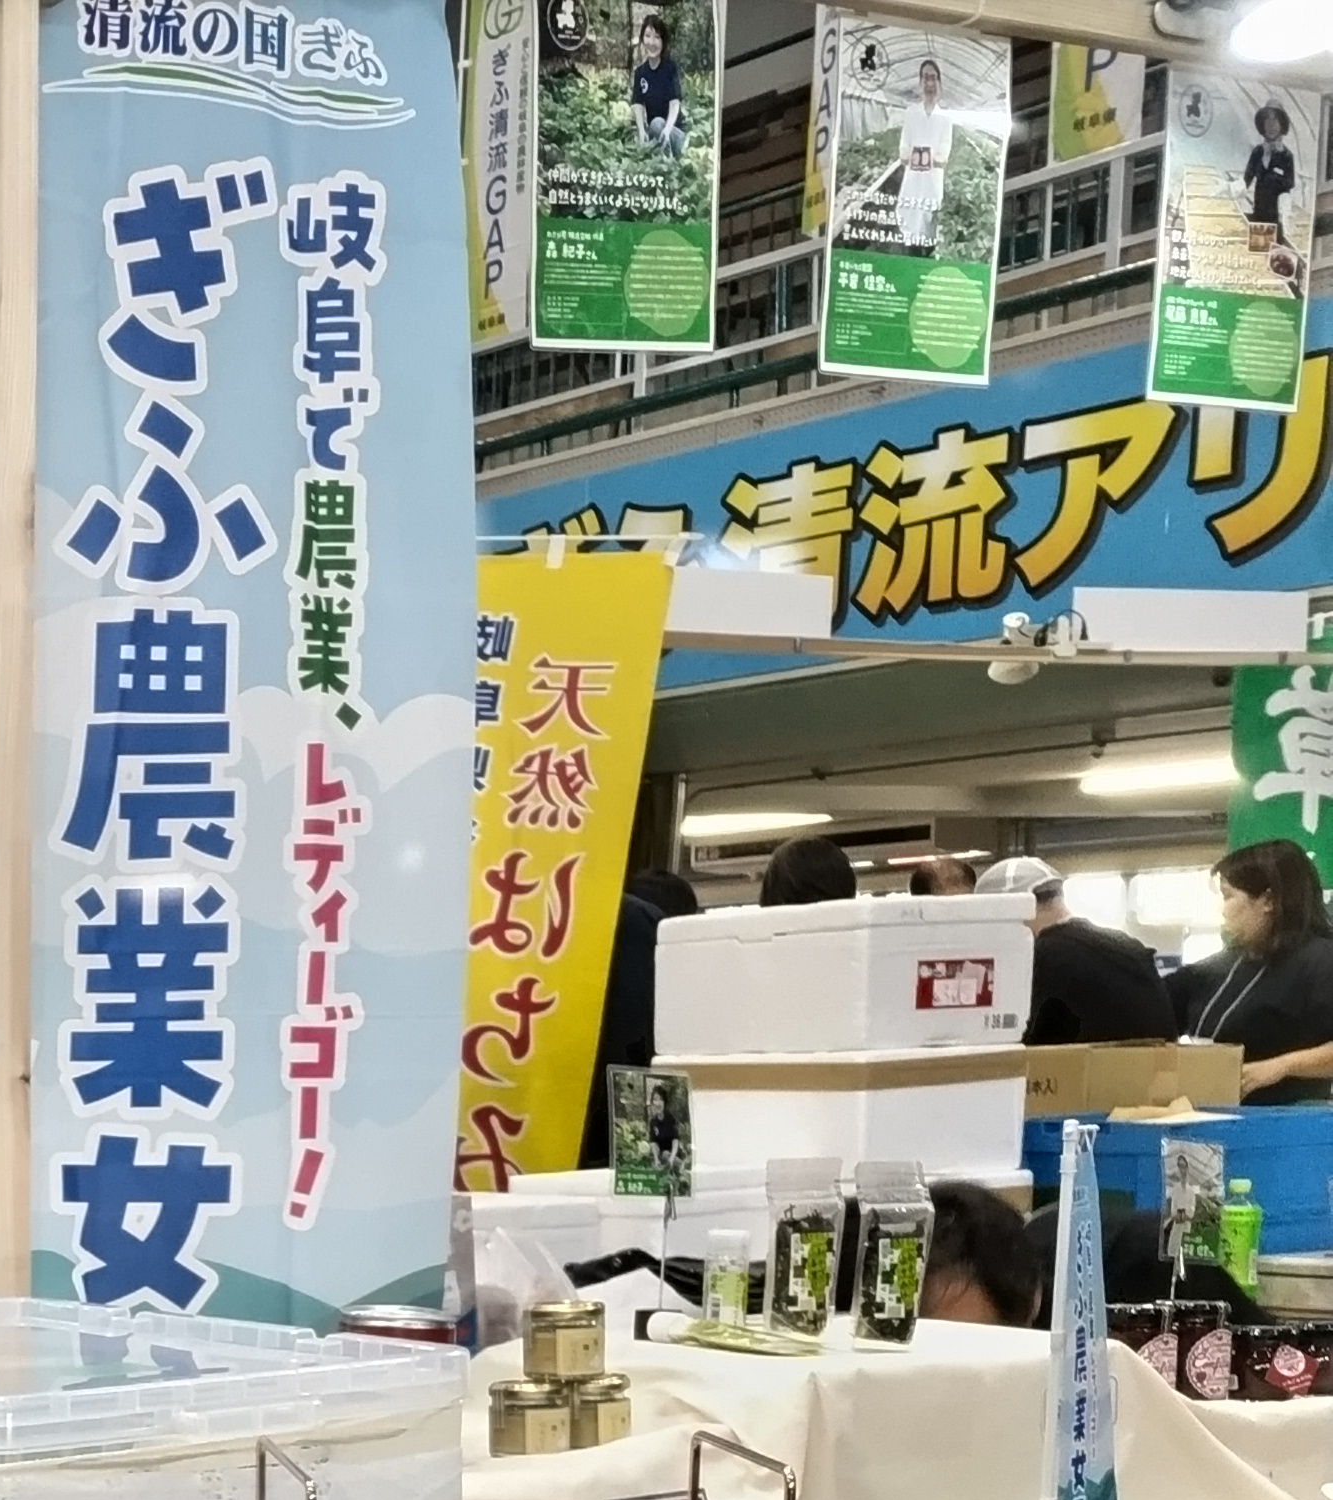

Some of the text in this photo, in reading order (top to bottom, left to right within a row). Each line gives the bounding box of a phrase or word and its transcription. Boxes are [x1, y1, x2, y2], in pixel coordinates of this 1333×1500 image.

[82, 0, 388, 84] 清流の国ぎふ
[485, 43, 512, 300] ぎふ清流GAP
[60, 170, 270, 1310] ぎふ農業女
